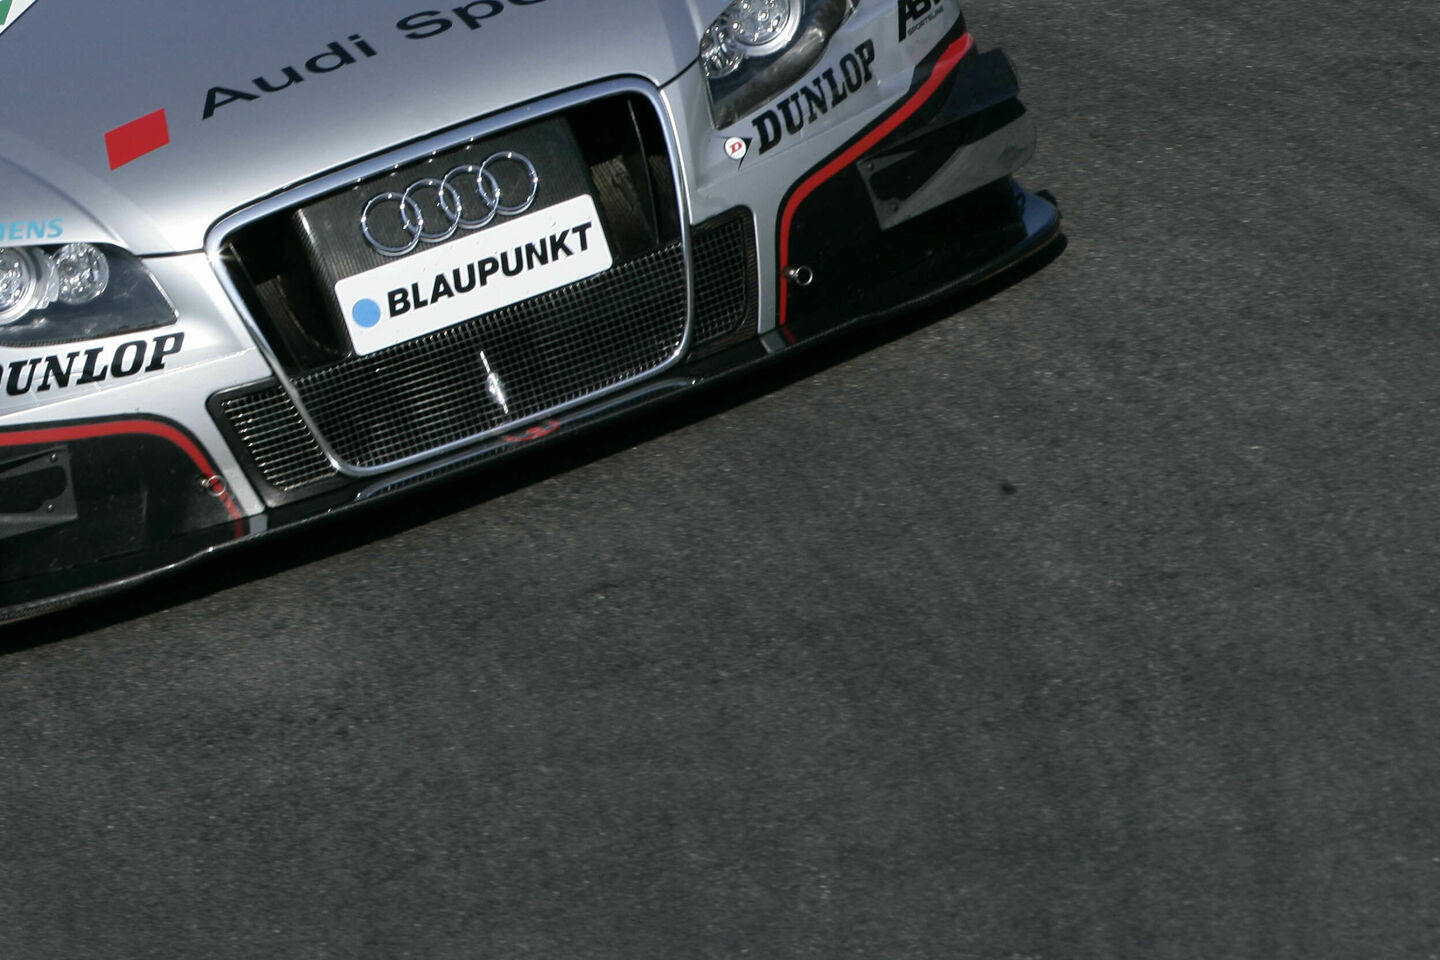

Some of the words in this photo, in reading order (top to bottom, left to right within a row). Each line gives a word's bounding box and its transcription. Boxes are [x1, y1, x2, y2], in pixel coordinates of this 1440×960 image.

[203, 33, 378, 120] Audi
[751, 39, 876, 156] DUNLOP
[387, 222, 593, 318] BLAUPUNKT
